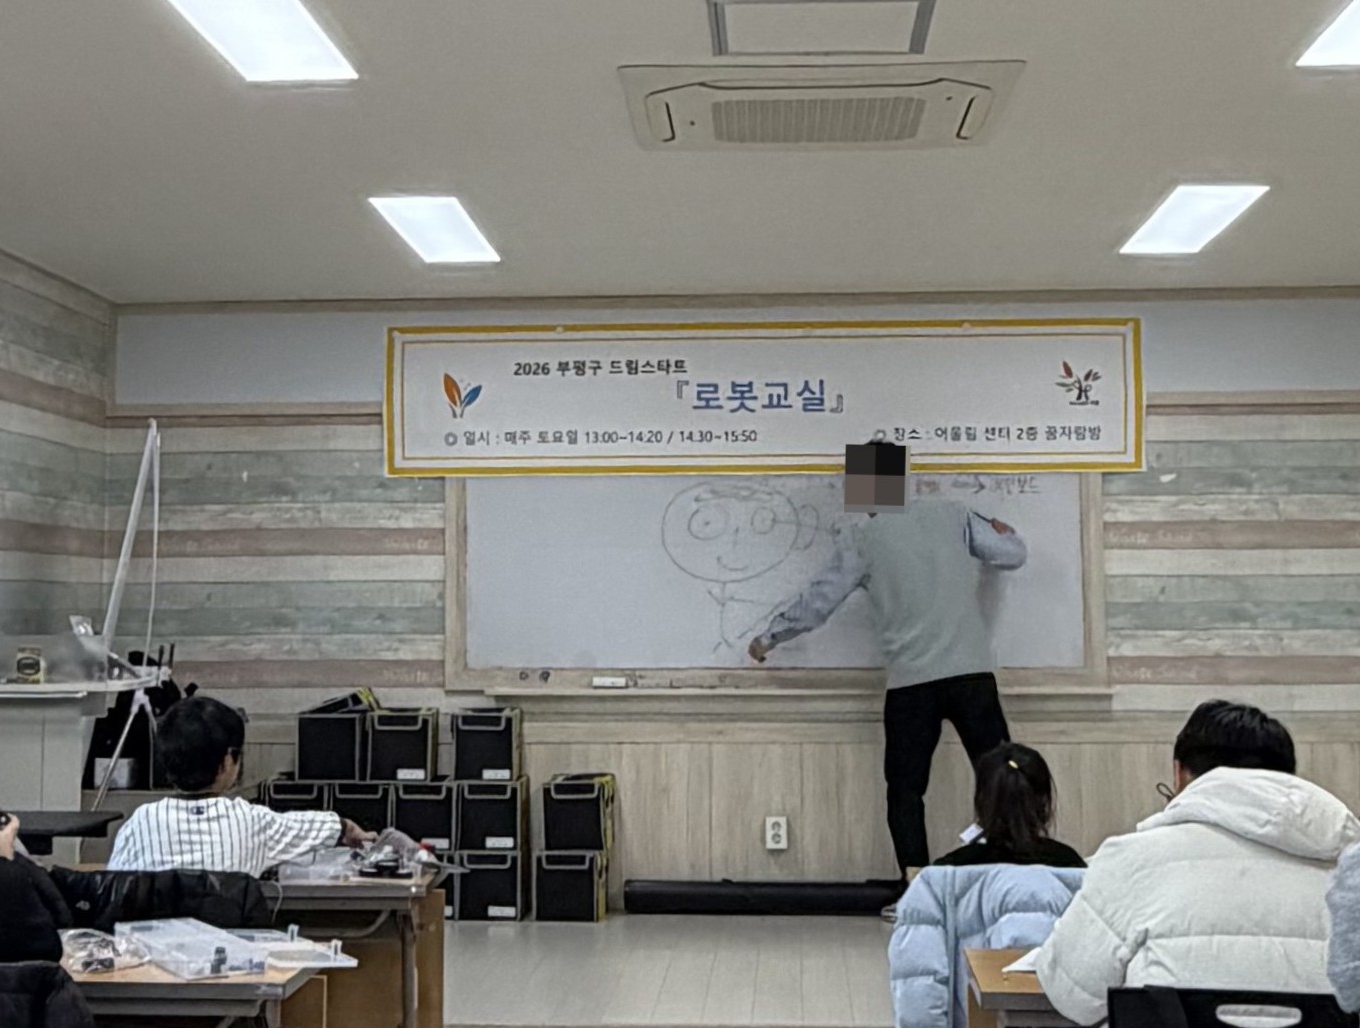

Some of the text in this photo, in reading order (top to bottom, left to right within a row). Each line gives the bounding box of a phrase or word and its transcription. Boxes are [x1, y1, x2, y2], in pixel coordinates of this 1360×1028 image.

[513, 360, 687, 376] 2026 부평구 드림스타트
[463, 430, 490, 446] 일시
[504, 430, 531, 446] 매주
[537, 430, 578, 446] 토요일
[893, 427, 921, 441] 장소
[935, 426, 977, 442] 어울림
